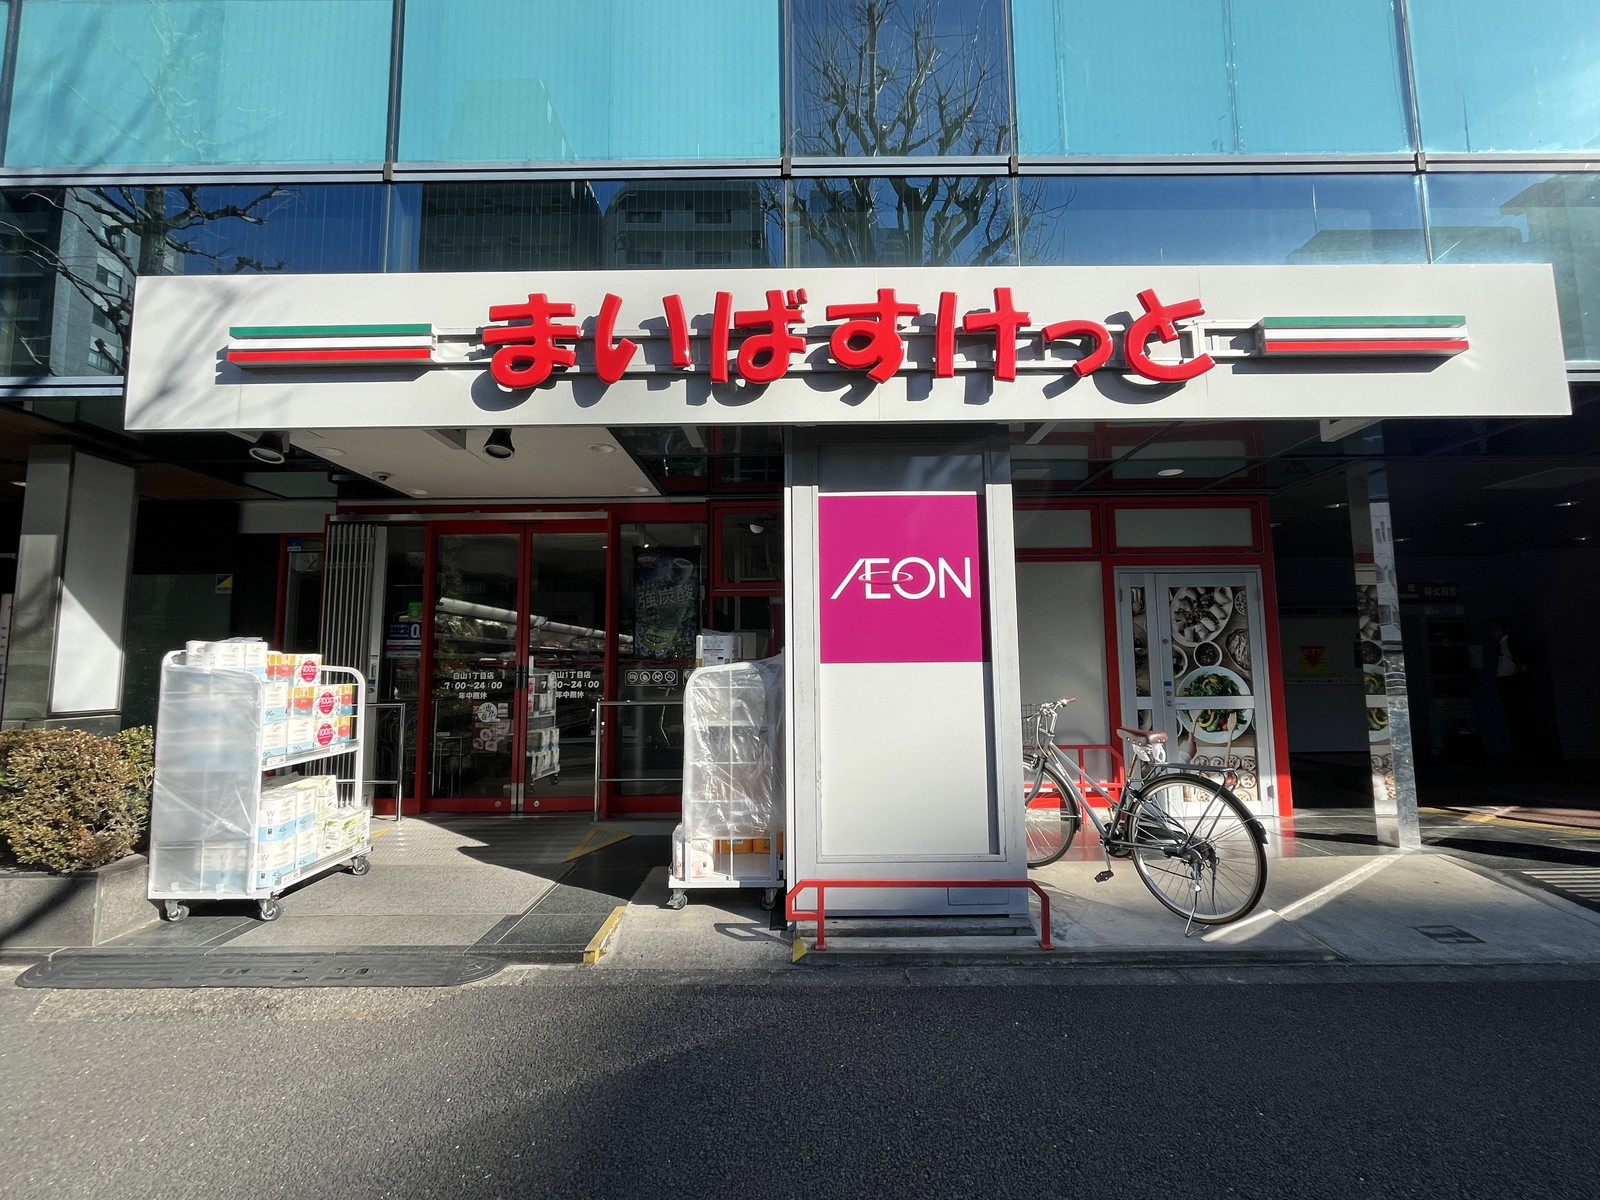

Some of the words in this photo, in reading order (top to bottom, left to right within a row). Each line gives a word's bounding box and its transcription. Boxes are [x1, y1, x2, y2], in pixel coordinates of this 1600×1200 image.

[481, 286, 1216, 389] まいばすけっと
[453, 671, 494, 680] 白山1丁目店
[549, 670, 592, 679] 白山1丁目店
[458, 691, 488, 700] 年中無休
[555, 690, 585, 699] 年中無休
